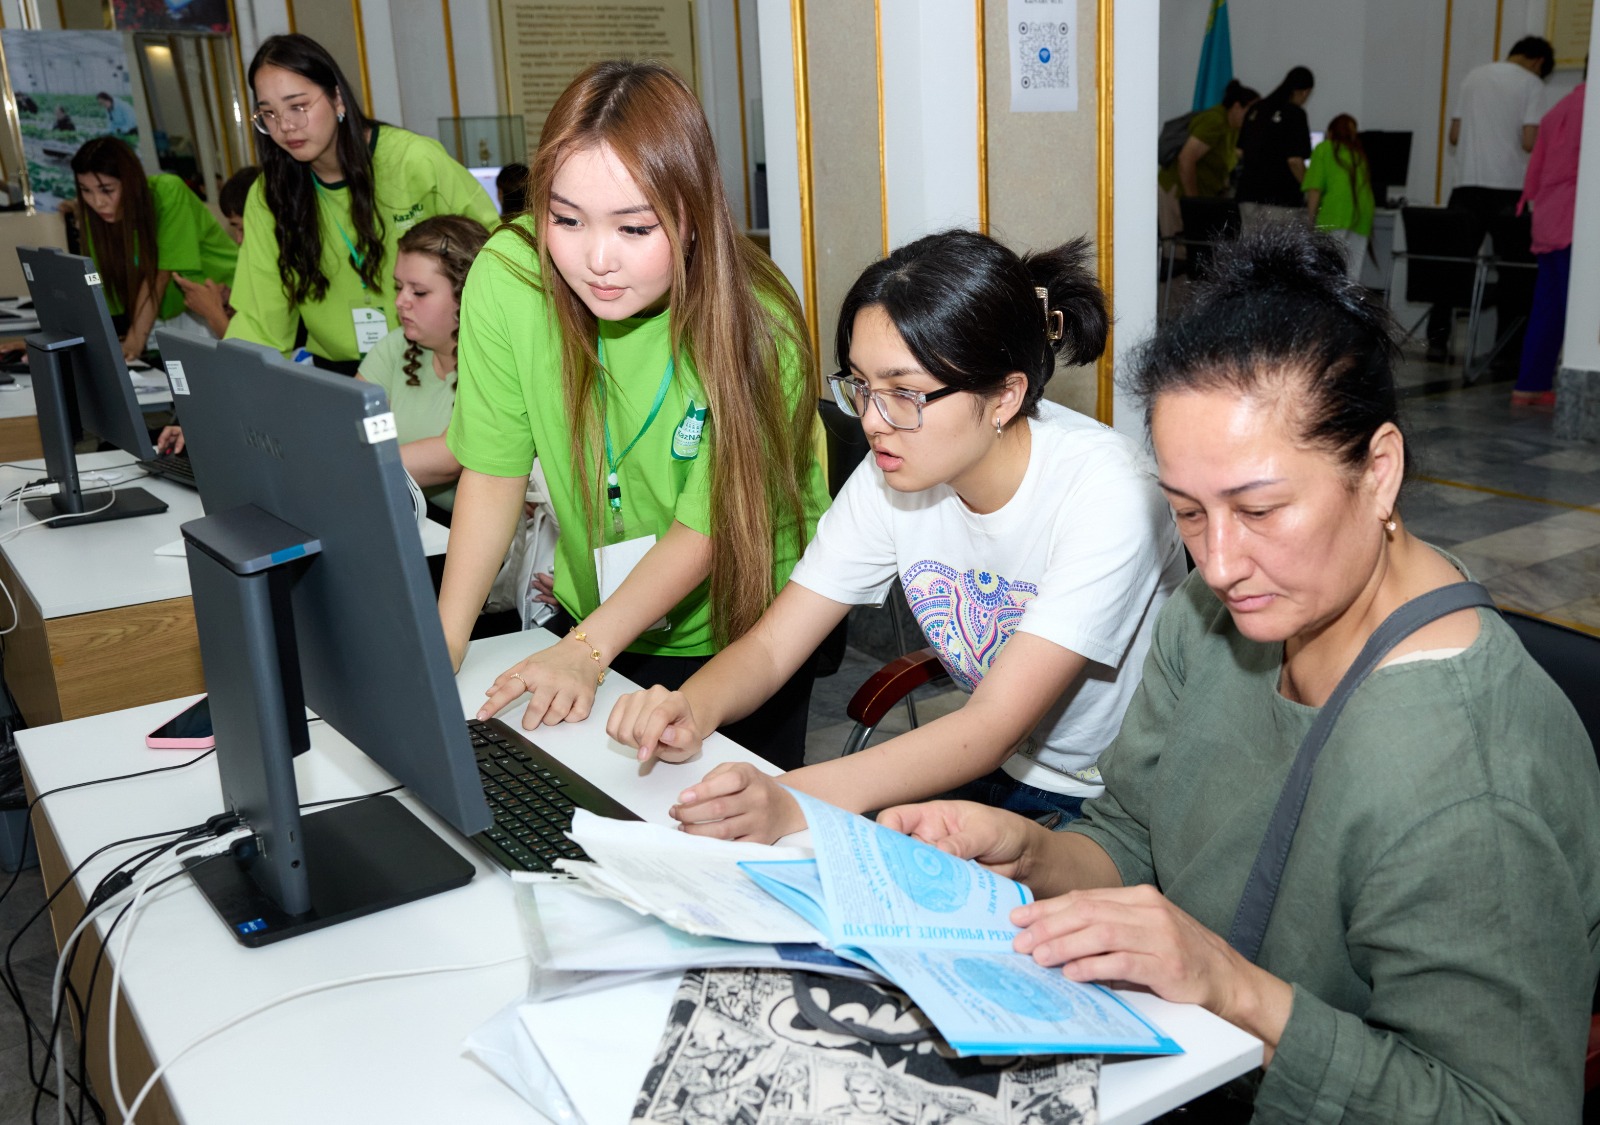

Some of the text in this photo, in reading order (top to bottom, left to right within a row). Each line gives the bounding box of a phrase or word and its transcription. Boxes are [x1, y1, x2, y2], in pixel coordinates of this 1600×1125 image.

[677, 429, 701, 441] KazNA
[843, 923, 912, 938] ПАСПОРТ
[918, 926, 985, 941] ЗДОРОВЬЯ
